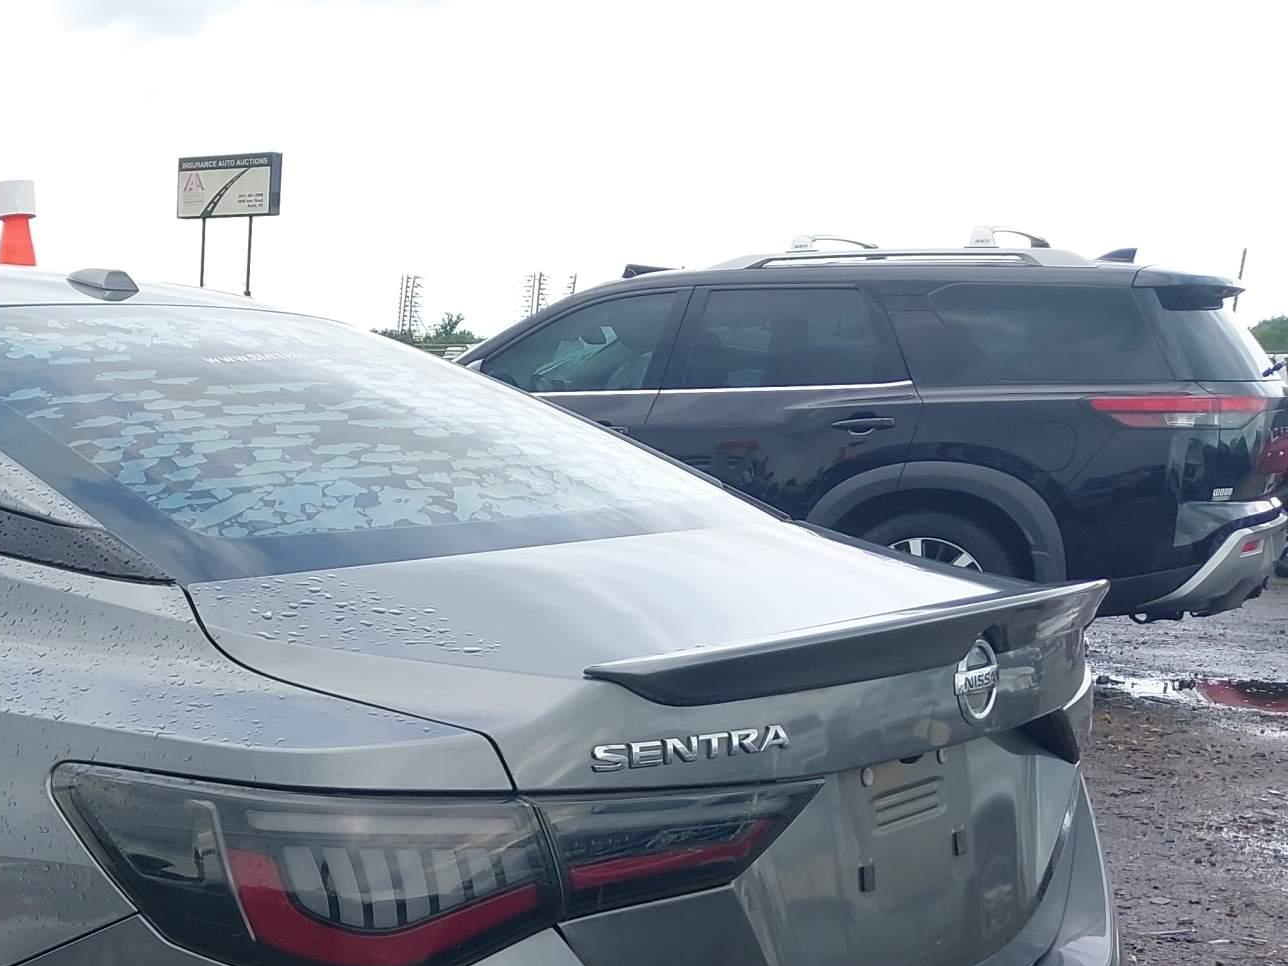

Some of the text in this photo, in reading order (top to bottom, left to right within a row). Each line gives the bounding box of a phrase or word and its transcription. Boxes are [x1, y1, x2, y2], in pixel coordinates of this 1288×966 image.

[182, 157, 269, 169] INSURANCE AUTO AUCTIONS
[591, 724, 791, 773] SENTRA
